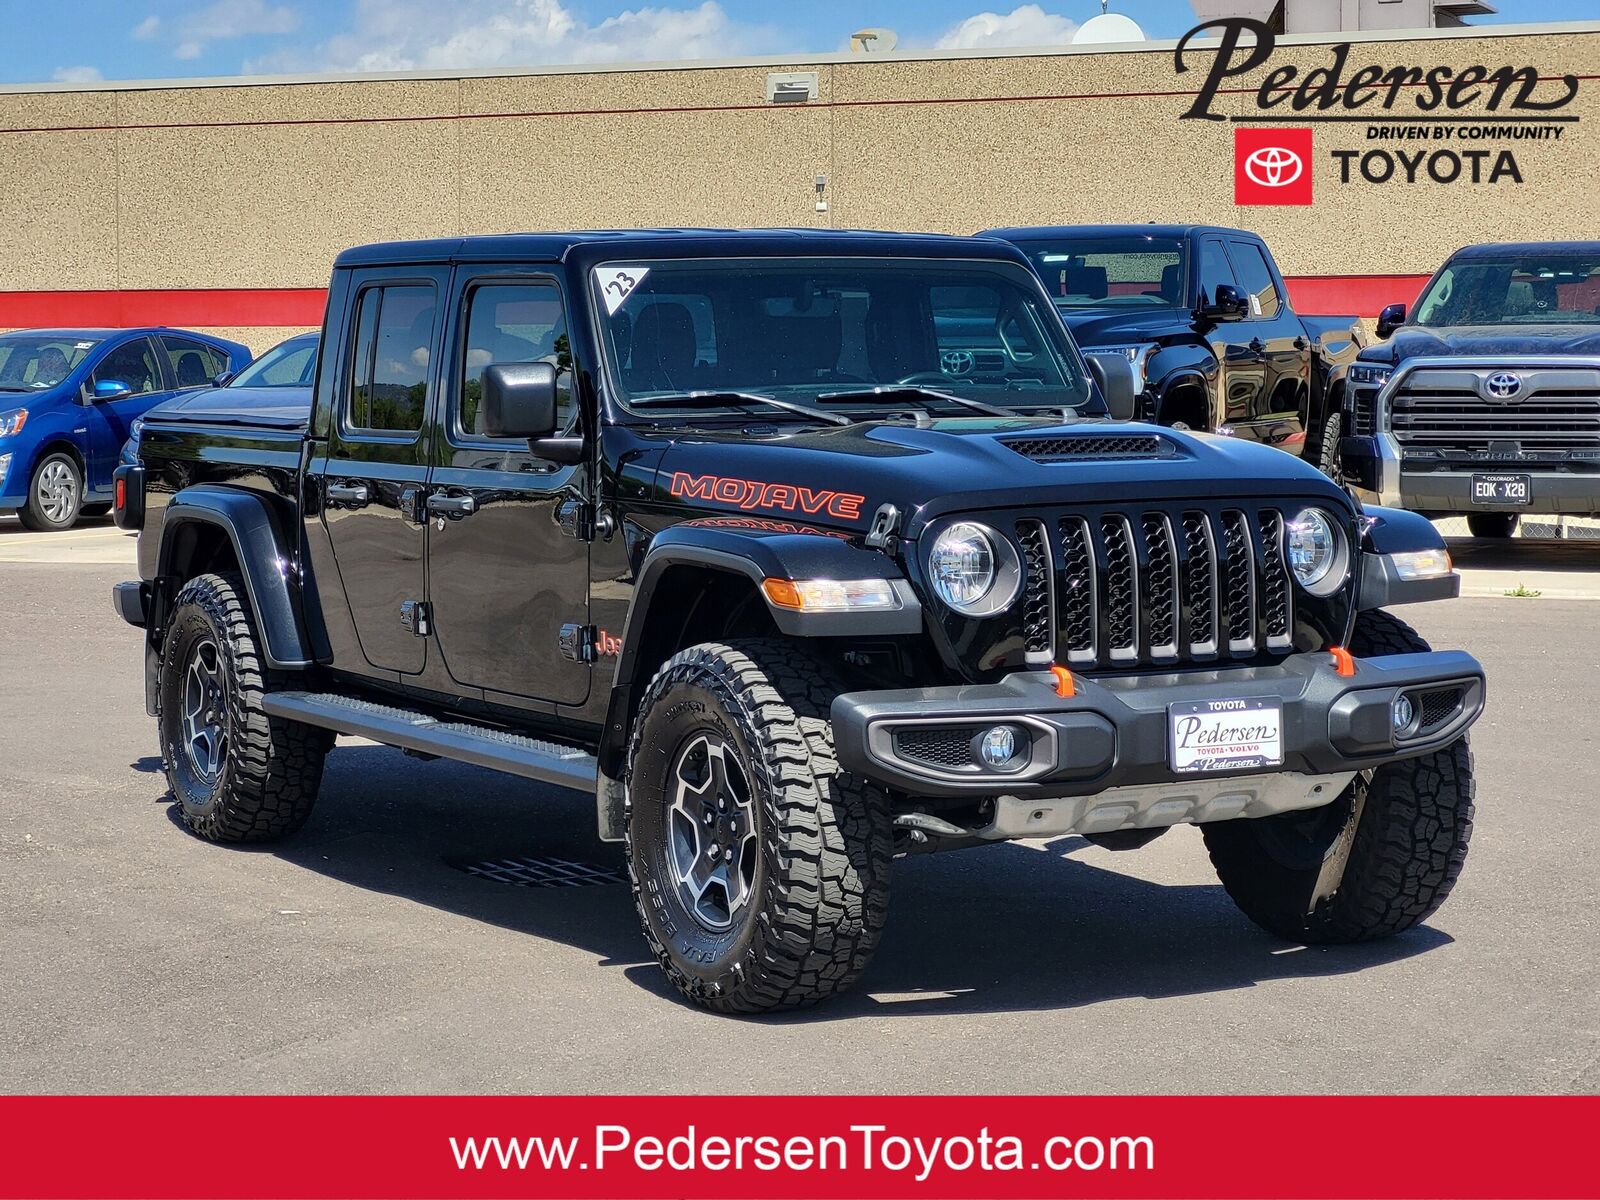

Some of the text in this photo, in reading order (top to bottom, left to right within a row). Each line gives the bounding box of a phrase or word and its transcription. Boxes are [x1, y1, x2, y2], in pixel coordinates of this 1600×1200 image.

[670, 471, 865, 520] MOJAVE
[1208, 700, 1246, 711] TOYOTA
[1176, 716, 1278, 749] Pedersen
[1197, 745, 1260, 755] TOYOTA VOLVO
[1200, 757, 1261, 771] Pedersen
